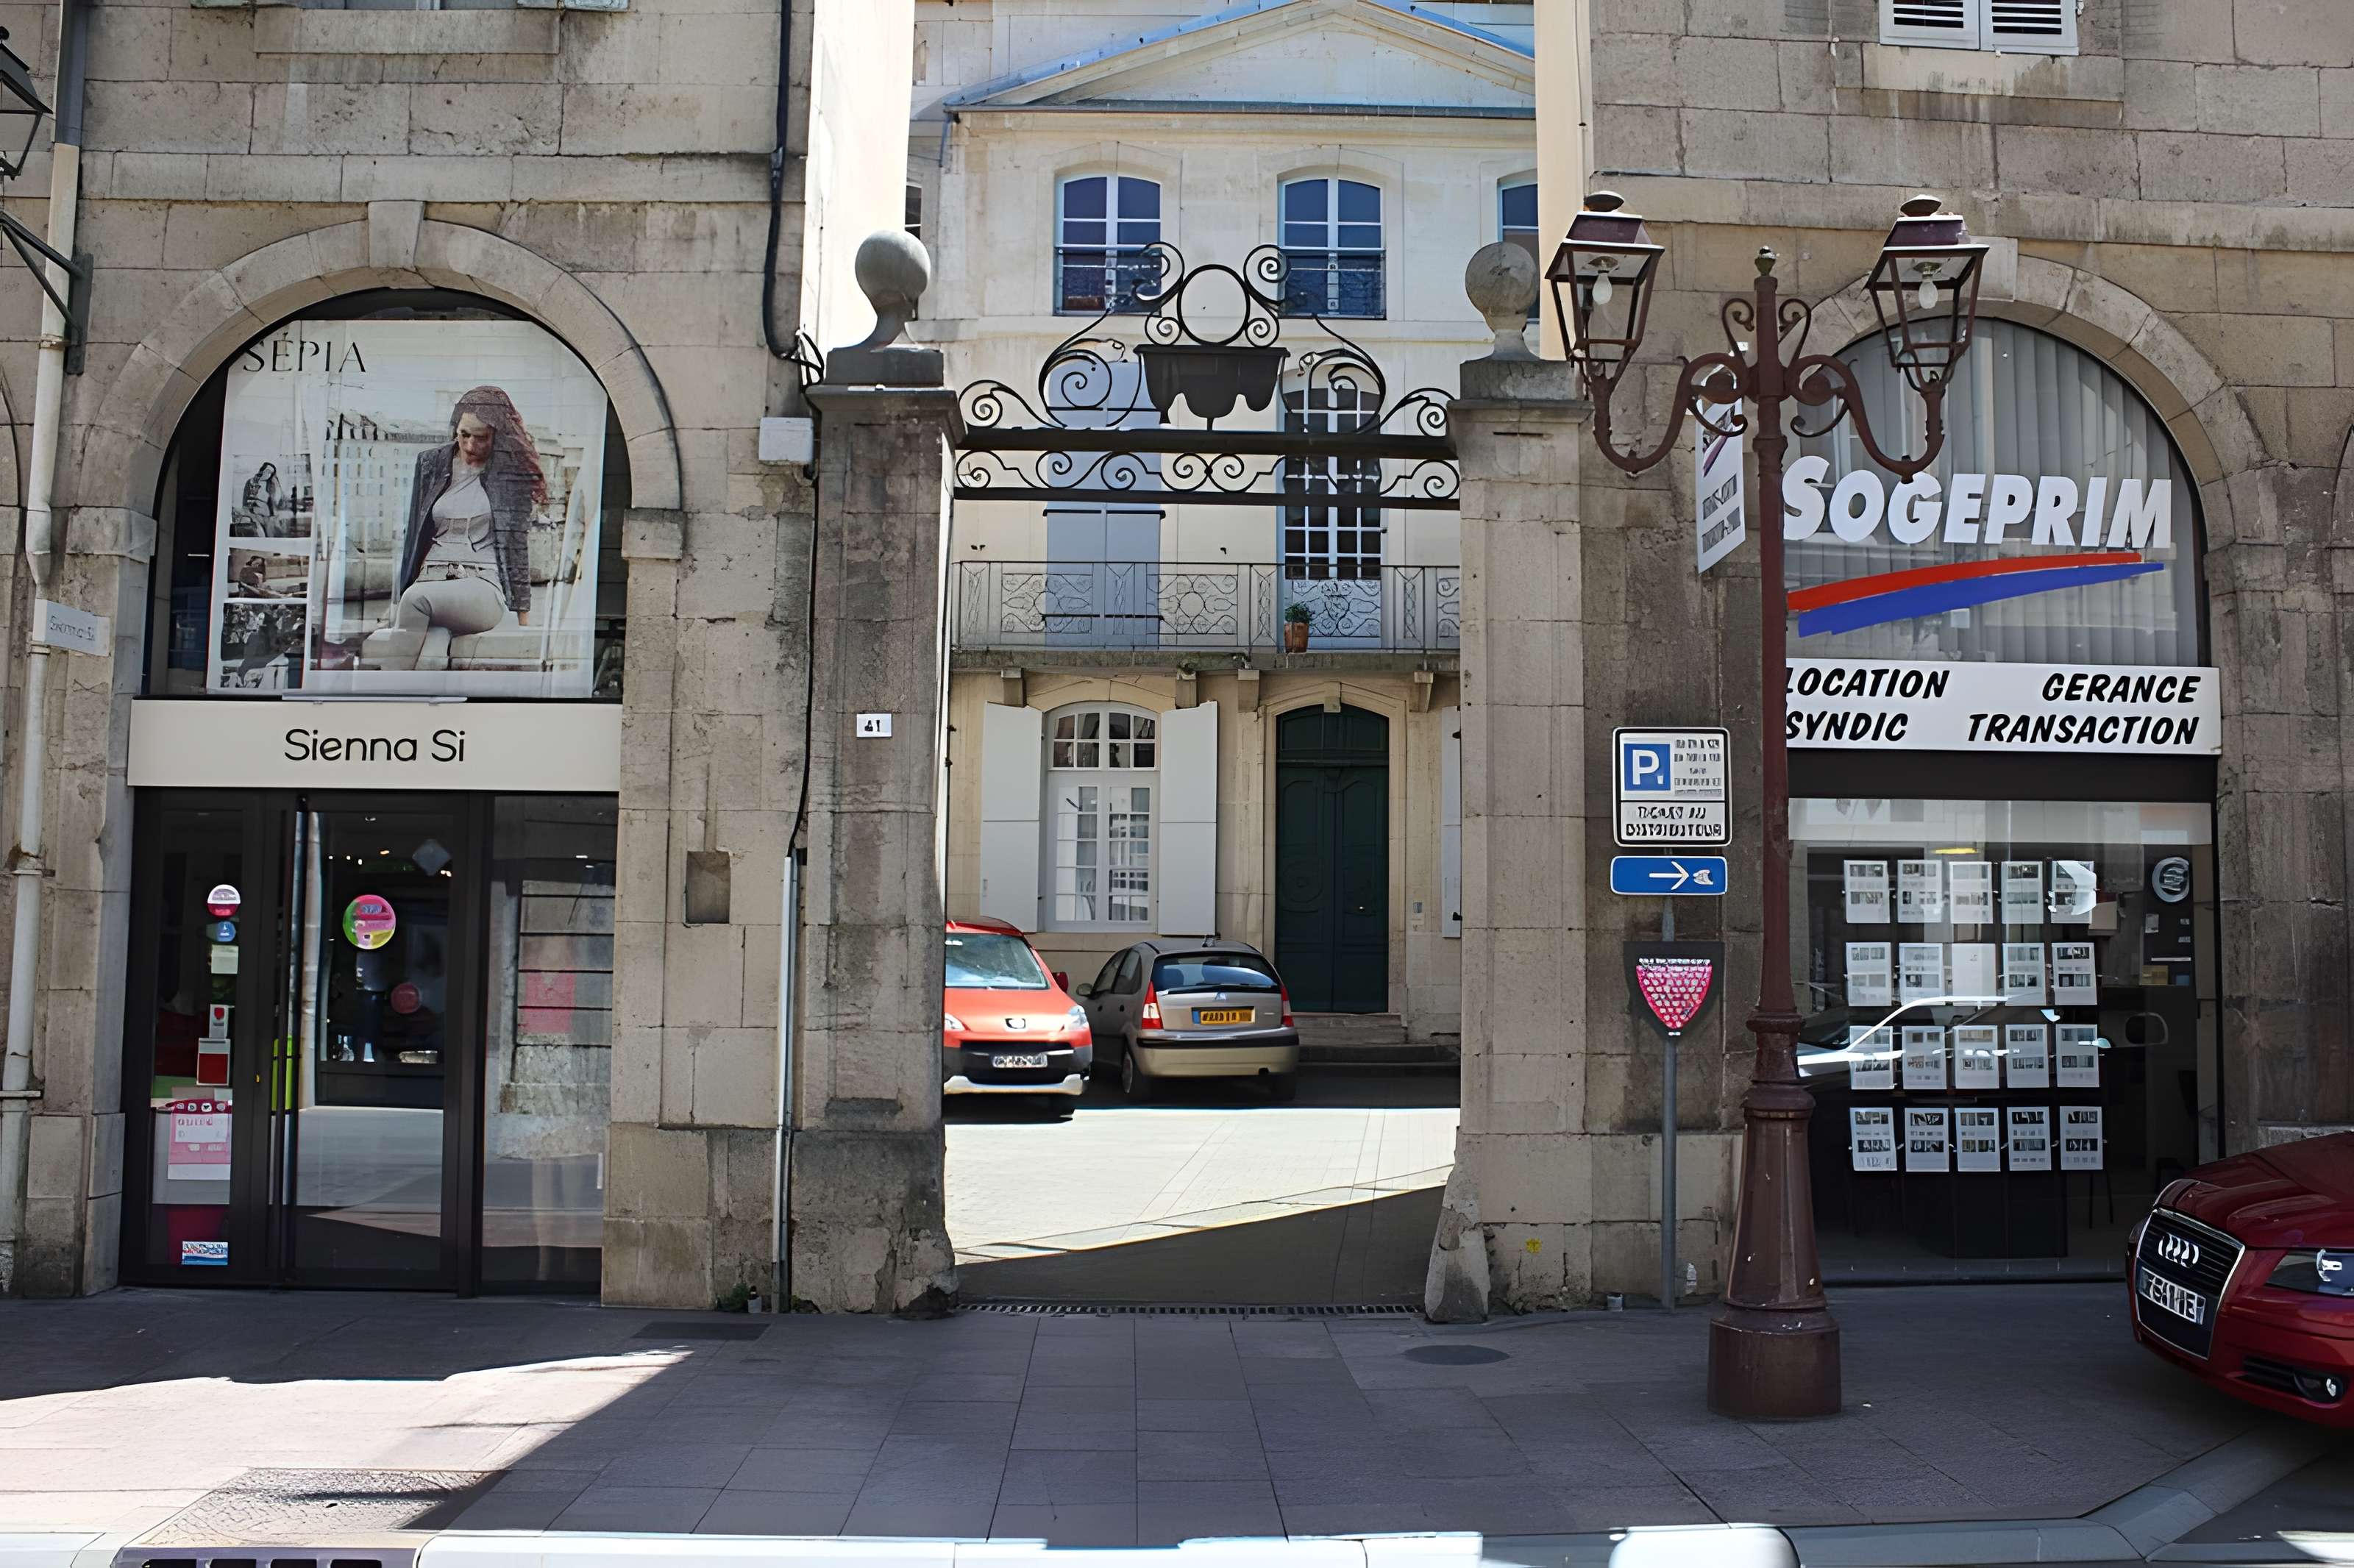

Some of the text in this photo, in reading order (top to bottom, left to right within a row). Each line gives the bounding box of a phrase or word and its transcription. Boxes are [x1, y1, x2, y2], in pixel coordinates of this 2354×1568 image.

[1782, 455, 2172, 549] SOGEPRIM
[2041, 673, 2202, 703] GERANCE
[1786, 710, 2200, 745] SYNDIC TRANSACTION
[284, 728, 466, 762] Sienna Si
